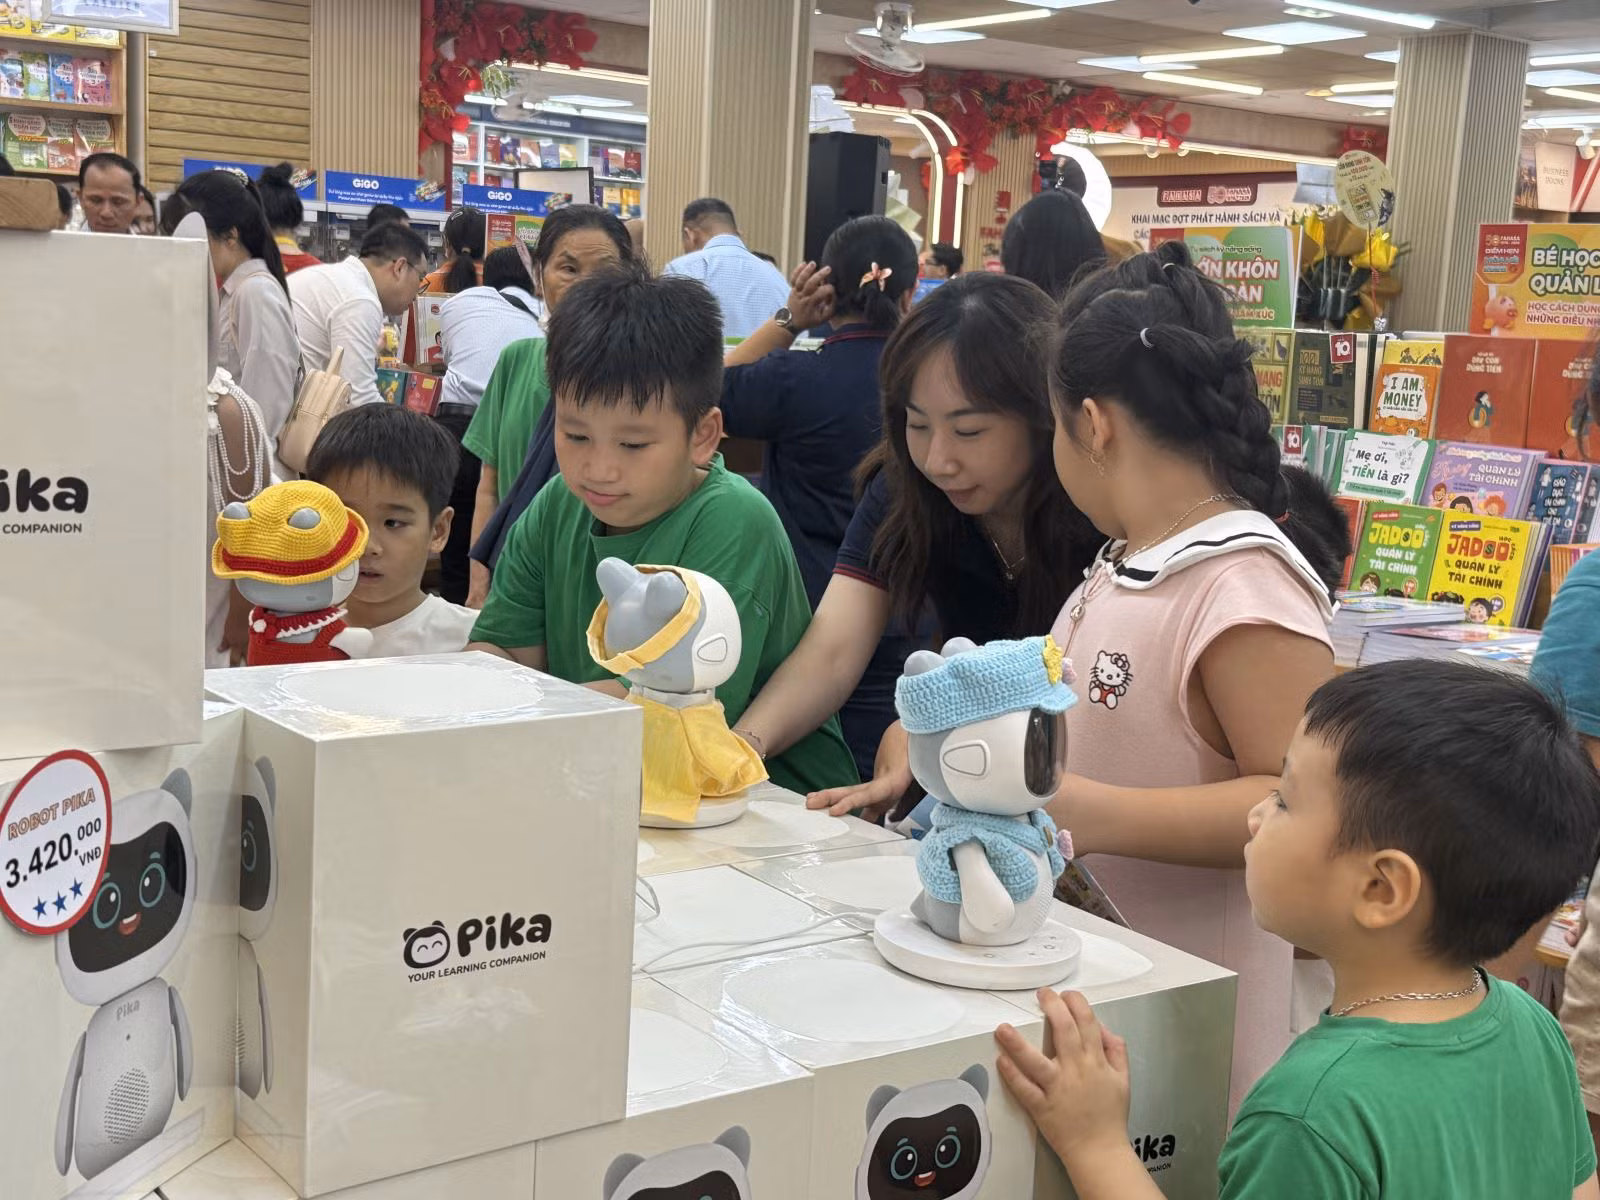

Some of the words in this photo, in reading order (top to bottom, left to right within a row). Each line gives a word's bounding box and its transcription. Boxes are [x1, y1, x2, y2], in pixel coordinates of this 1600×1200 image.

[1131, 214, 1150, 224] KHAI
[1191, 212, 1213, 224] PHÁT
[1215, 211, 1240, 223] HÀNH
[1242, 210, 1268, 222] SÁCH
[1269, 210, 1281, 222] VÀ
[1195, 256, 1222, 278] ỚN
[1225, 256, 1279, 279] KHÔN
[1533, 244, 1558, 266] BÉ
[1560, 249, 1600, 272] HỌC
[1529, 269, 1589, 296] QUẢN
[1527, 303, 1548, 313] HỌC
[1549, 302, 1575, 313] CÁCH
[1526, 313, 1561, 324] NHỮNG
[1561, 314, 1585, 325] ĐIỀU
[1391, 377, 1398, 389] I
[1401, 377, 1419, 391] AM
[1383, 391, 1422, 407] MONEY
[1355, 449, 1371, 463] Mẹ
[1374, 451, 1388, 464] ơi,
[1351, 463, 1375, 479] TIỀN
[1377, 470, 1388, 482] là
[1391, 473, 1410, 486] gì?
[1485, 475, 1518, 487] CHÍNH
[0, 468, 89, 514] ika
[2, 523, 82, 534] COMPANION
[1368, 522, 1425, 549] JADOO
[1376, 546, 1403, 560] QUẢN
[1404, 550, 1416, 561] LÝ
[1446, 533, 1510, 561] JADOO
[1387, 562, 1418, 575] CHÍNH
[1455, 558, 1486, 572] QUẢN
[1488, 562, 1501, 574] LÝ
[1448, 571, 1466, 583] TÀI
[1468, 575, 1503, 589] CHÍNH
[7, 802, 60, 841] ROBOT
[62, 787, 97, 816] PIKA
[79, 846, 102, 867] VNĐ
[457, 912, 552, 957] Pika
[407, 970, 436, 983] YOUR
[438, 961, 487, 978] LEARNING
[489, 950, 547, 968] COMPANION
[116, 999, 140, 1021] Pika
[1130, 1134, 1176, 1162] ika
[1146, 1162, 1172, 1174] PANION
